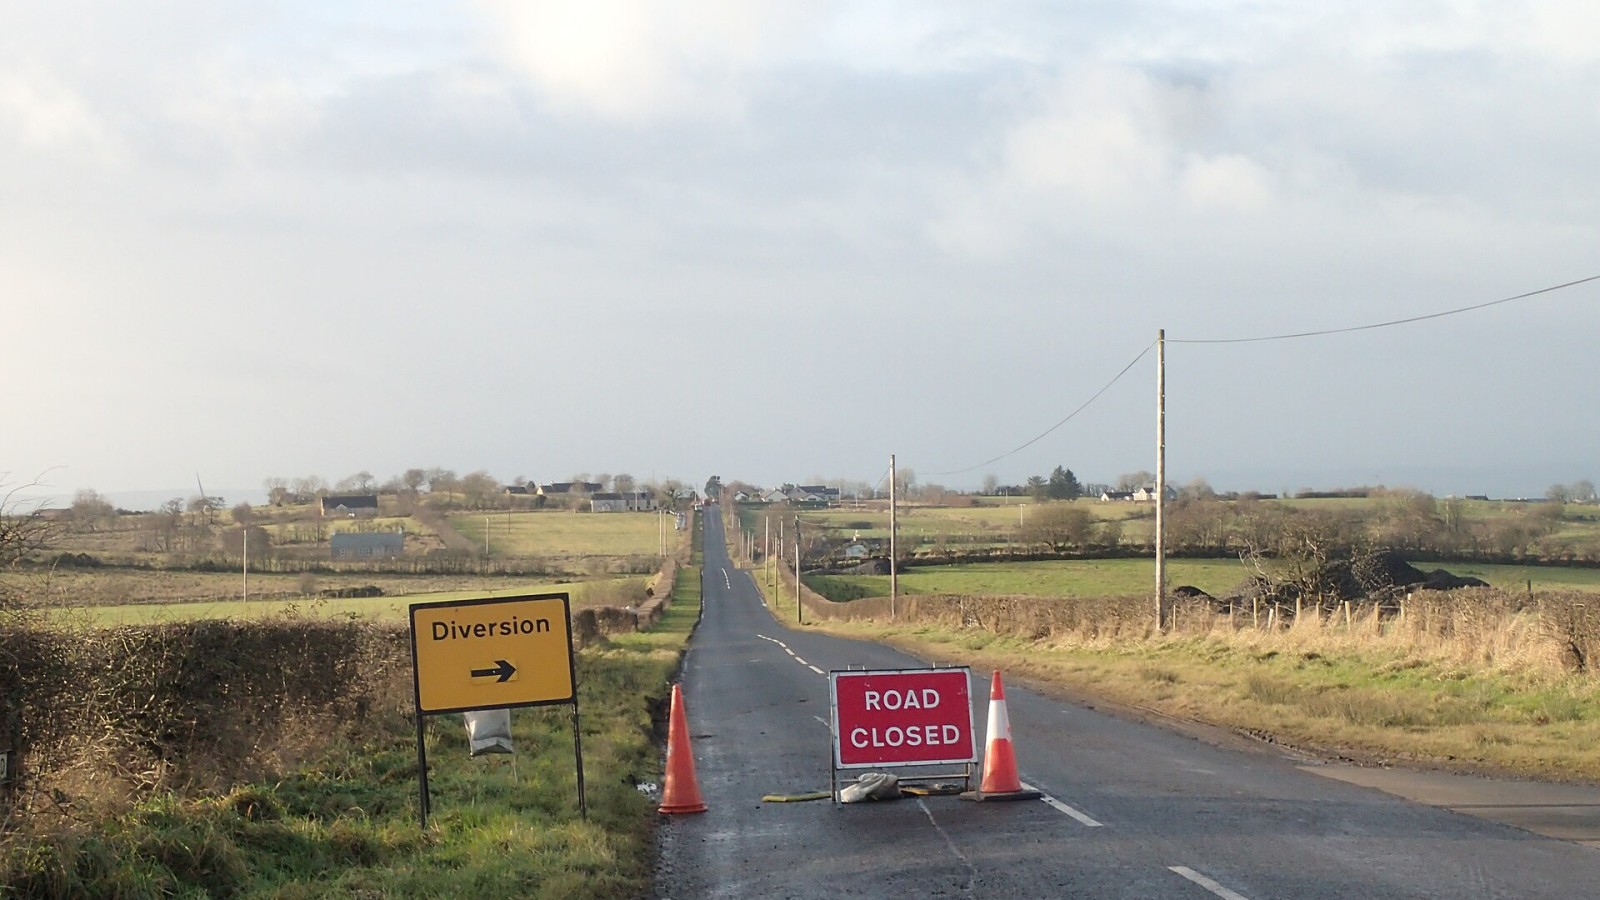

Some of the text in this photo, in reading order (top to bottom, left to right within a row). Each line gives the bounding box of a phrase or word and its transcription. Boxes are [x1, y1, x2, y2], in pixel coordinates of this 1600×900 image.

[432, 616, 550, 640] Diversion
[865, 689, 940, 711] ROAD
[851, 725, 960, 748] CLOSED
